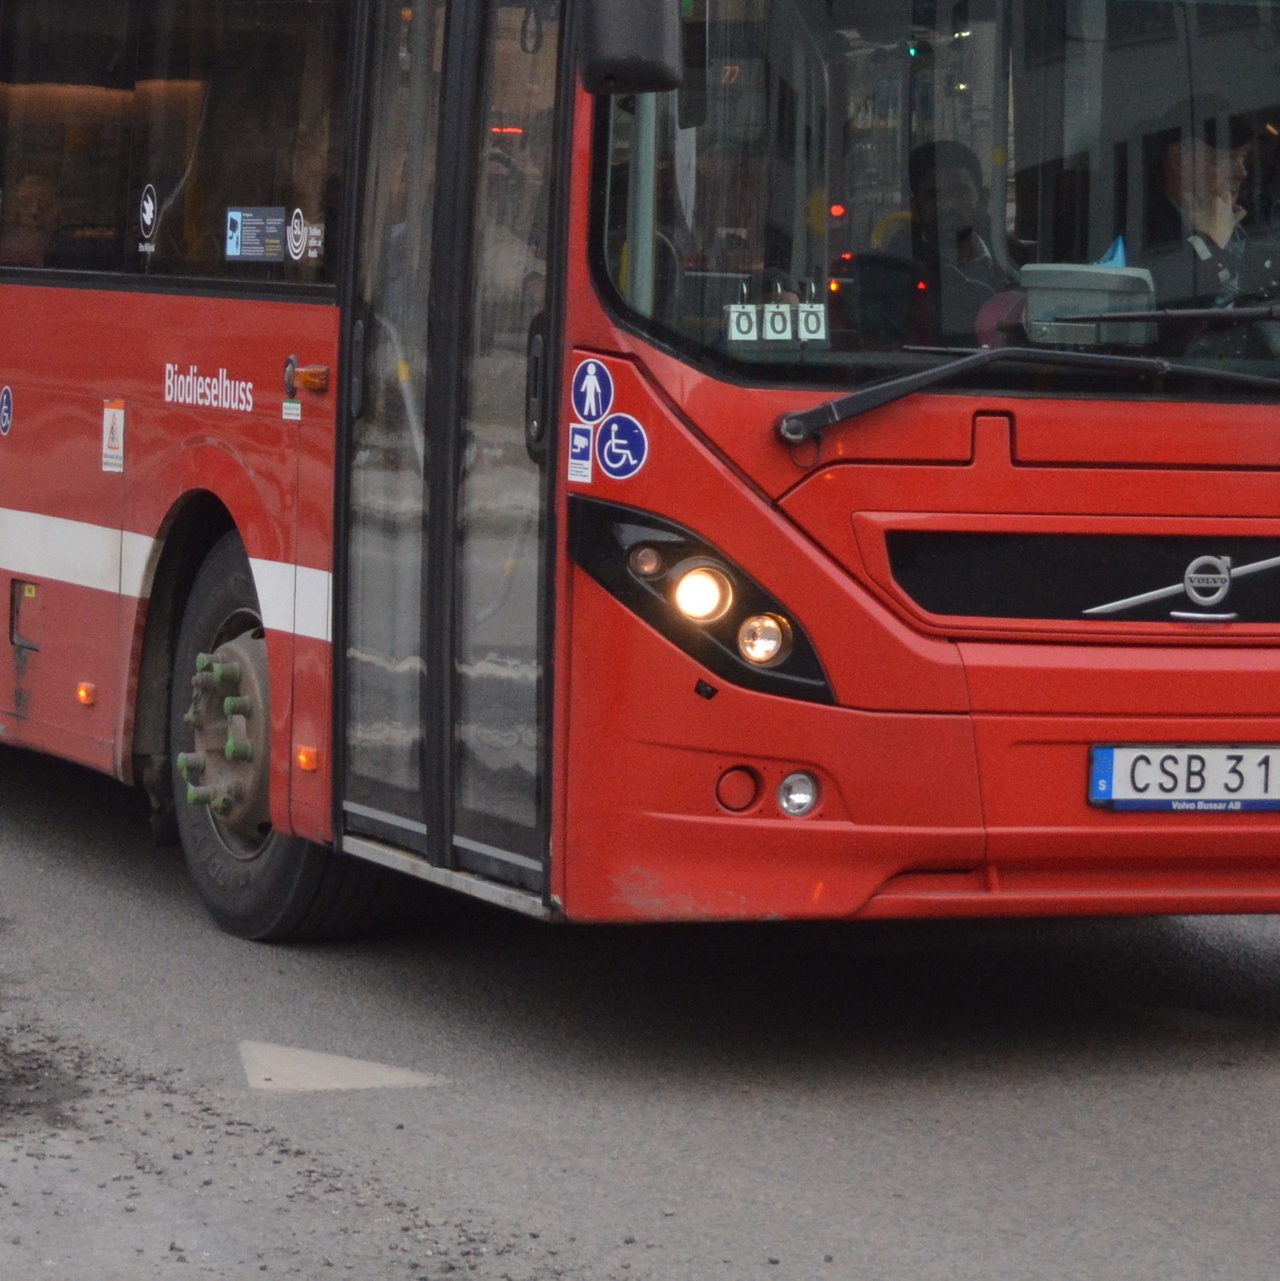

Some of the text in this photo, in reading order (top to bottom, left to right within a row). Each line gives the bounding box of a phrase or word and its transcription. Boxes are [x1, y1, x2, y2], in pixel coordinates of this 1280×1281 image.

[165, 362, 254, 413] Biodieselbuss
[1188, 577, 1228, 585] VOLVO
[1097, 780, 1107, 791] S
[1129, 753, 1206, 794] CSB
[1171, 800, 1242, 811] Volvo Bussar AB
